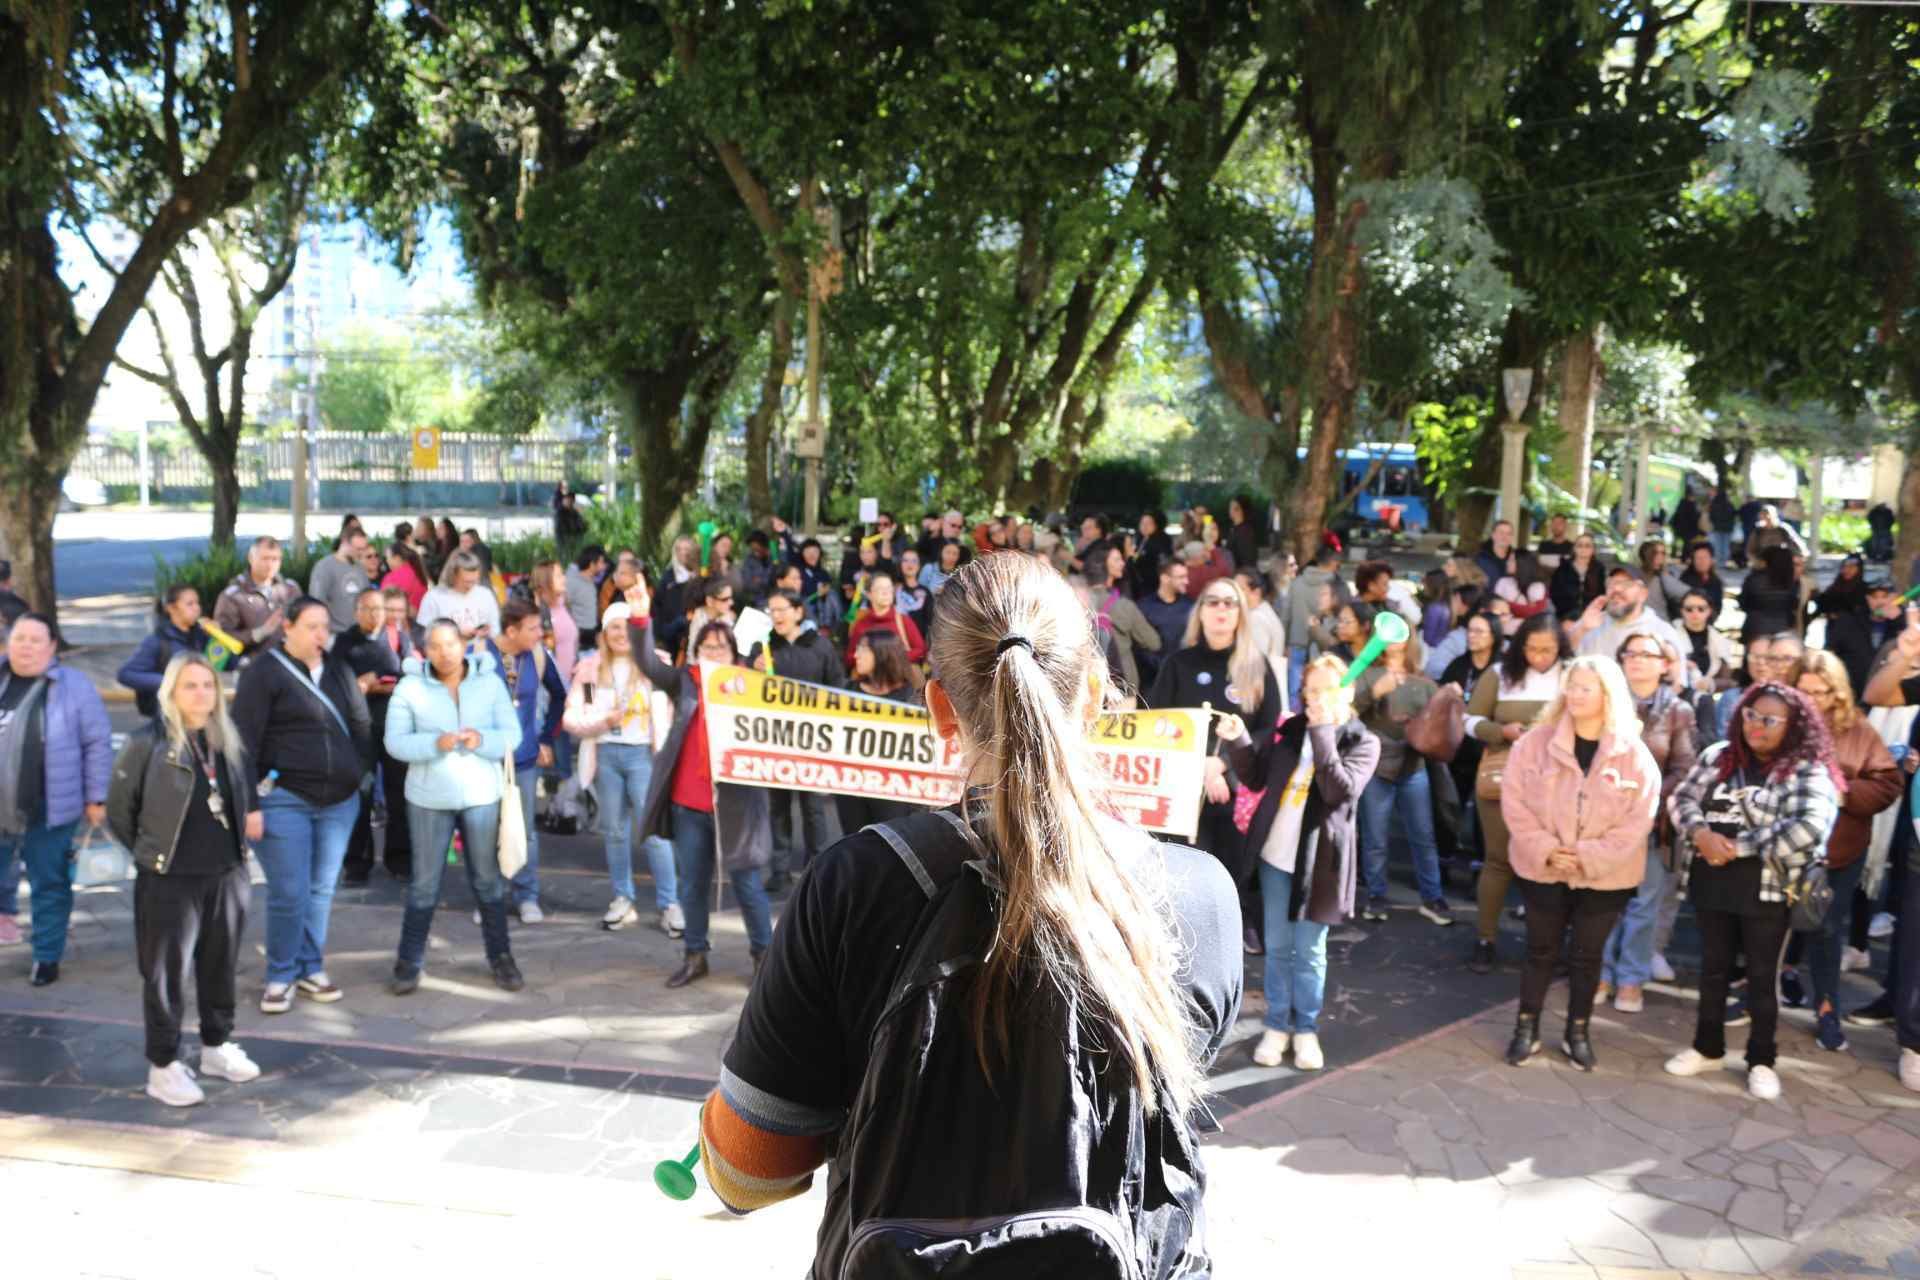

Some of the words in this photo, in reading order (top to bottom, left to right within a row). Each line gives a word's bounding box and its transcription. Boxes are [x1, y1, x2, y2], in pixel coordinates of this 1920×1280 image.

[762, 677, 817, 707] COM
[734, 714, 833, 752] SOMOS
[843, 726, 936, 764] TODAS
[732, 754, 961, 800] ENQUADRAME
